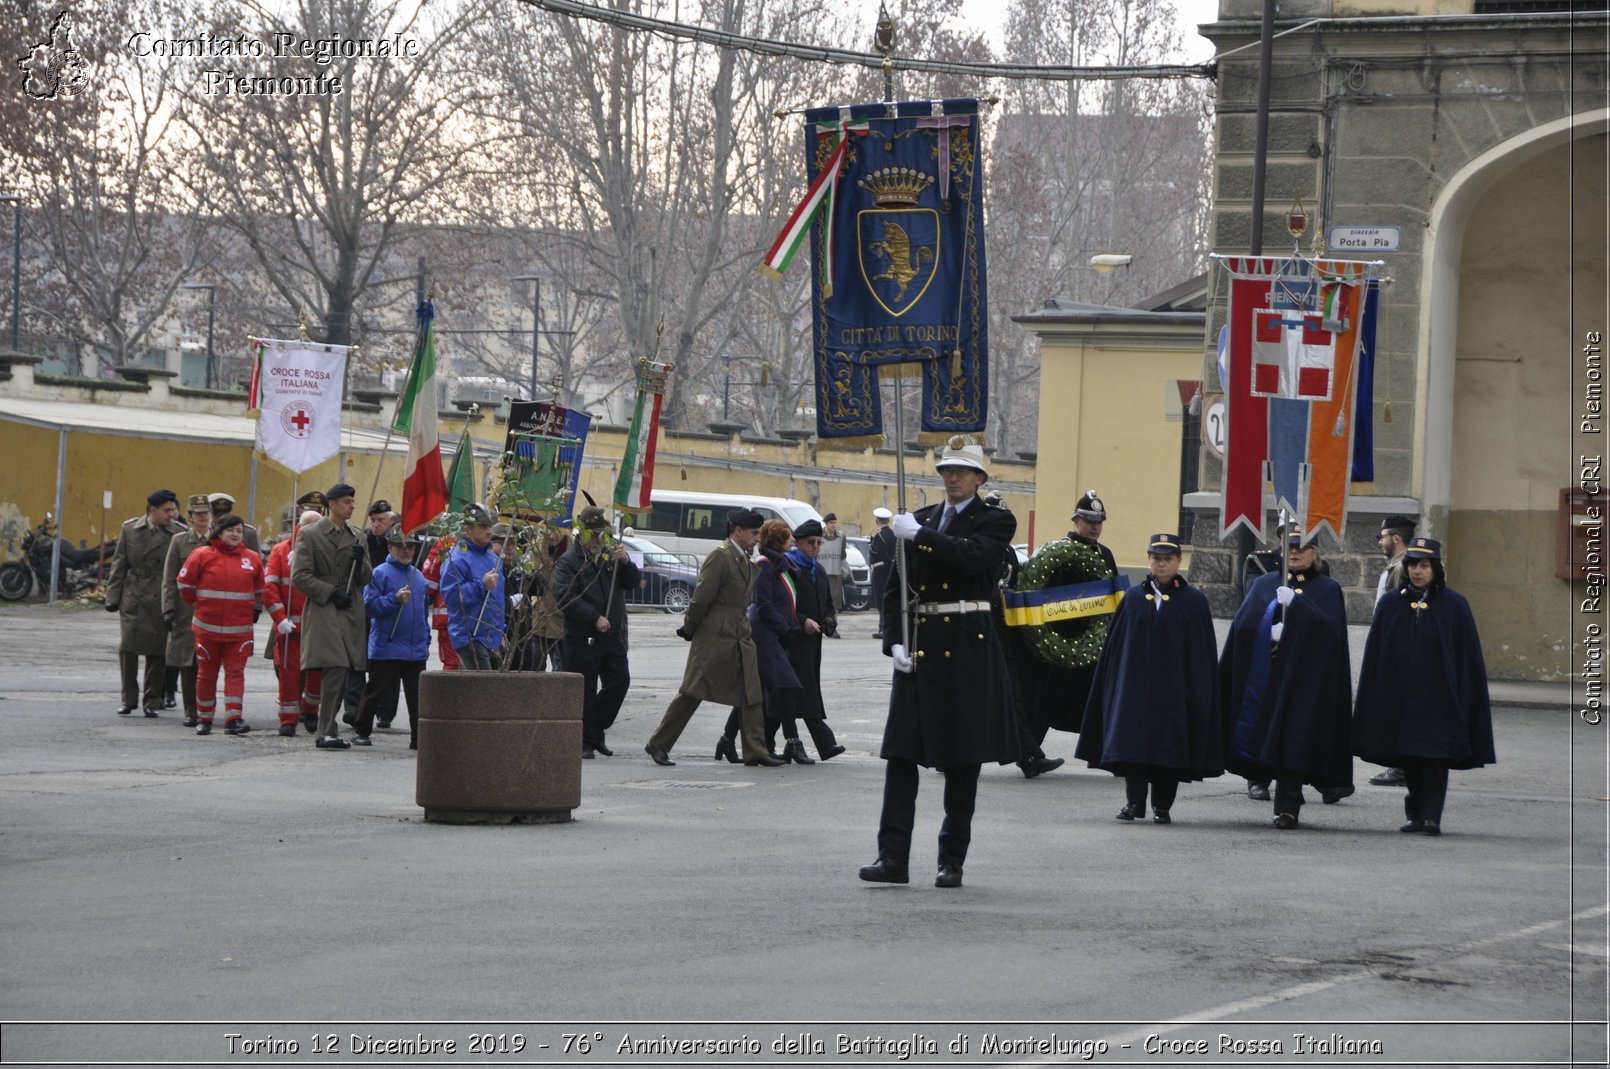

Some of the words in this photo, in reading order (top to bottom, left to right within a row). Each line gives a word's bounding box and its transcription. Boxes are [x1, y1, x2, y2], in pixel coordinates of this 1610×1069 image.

[1340, 238, 1367, 247] Porta
[1374, 238, 1389, 247] Pia
[887, 326, 901, 342] DI
[904, 325, 959, 342] TORINO
[271, 368, 300, 377] CROCE
[304, 370, 330, 380] ROSSA
[281, 379, 318, 389] ITALIANA
